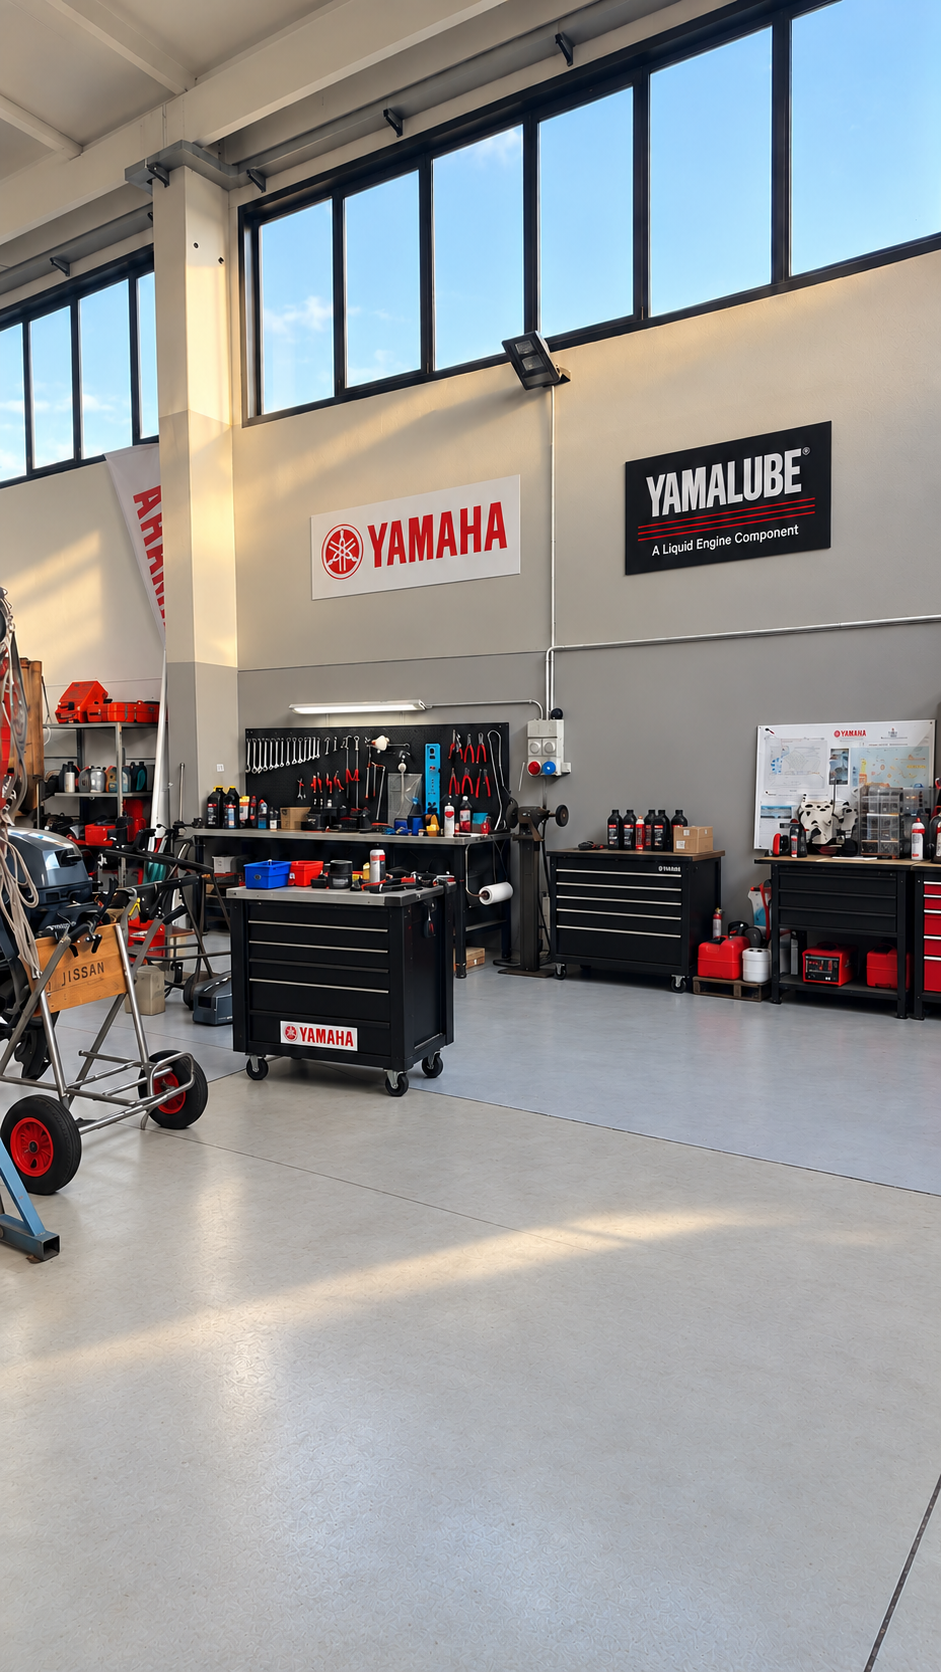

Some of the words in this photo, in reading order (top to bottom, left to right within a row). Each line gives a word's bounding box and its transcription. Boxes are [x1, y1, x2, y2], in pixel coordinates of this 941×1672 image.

[367, 501, 508, 568] YAMAHA
[652, 545, 660, 556] A
[662, 540, 694, 555] Liquid
[696, 536, 732, 550] Engine
[734, 524, 799, 543] Component
[299, 1026, 354, 1047] YAMAHA
